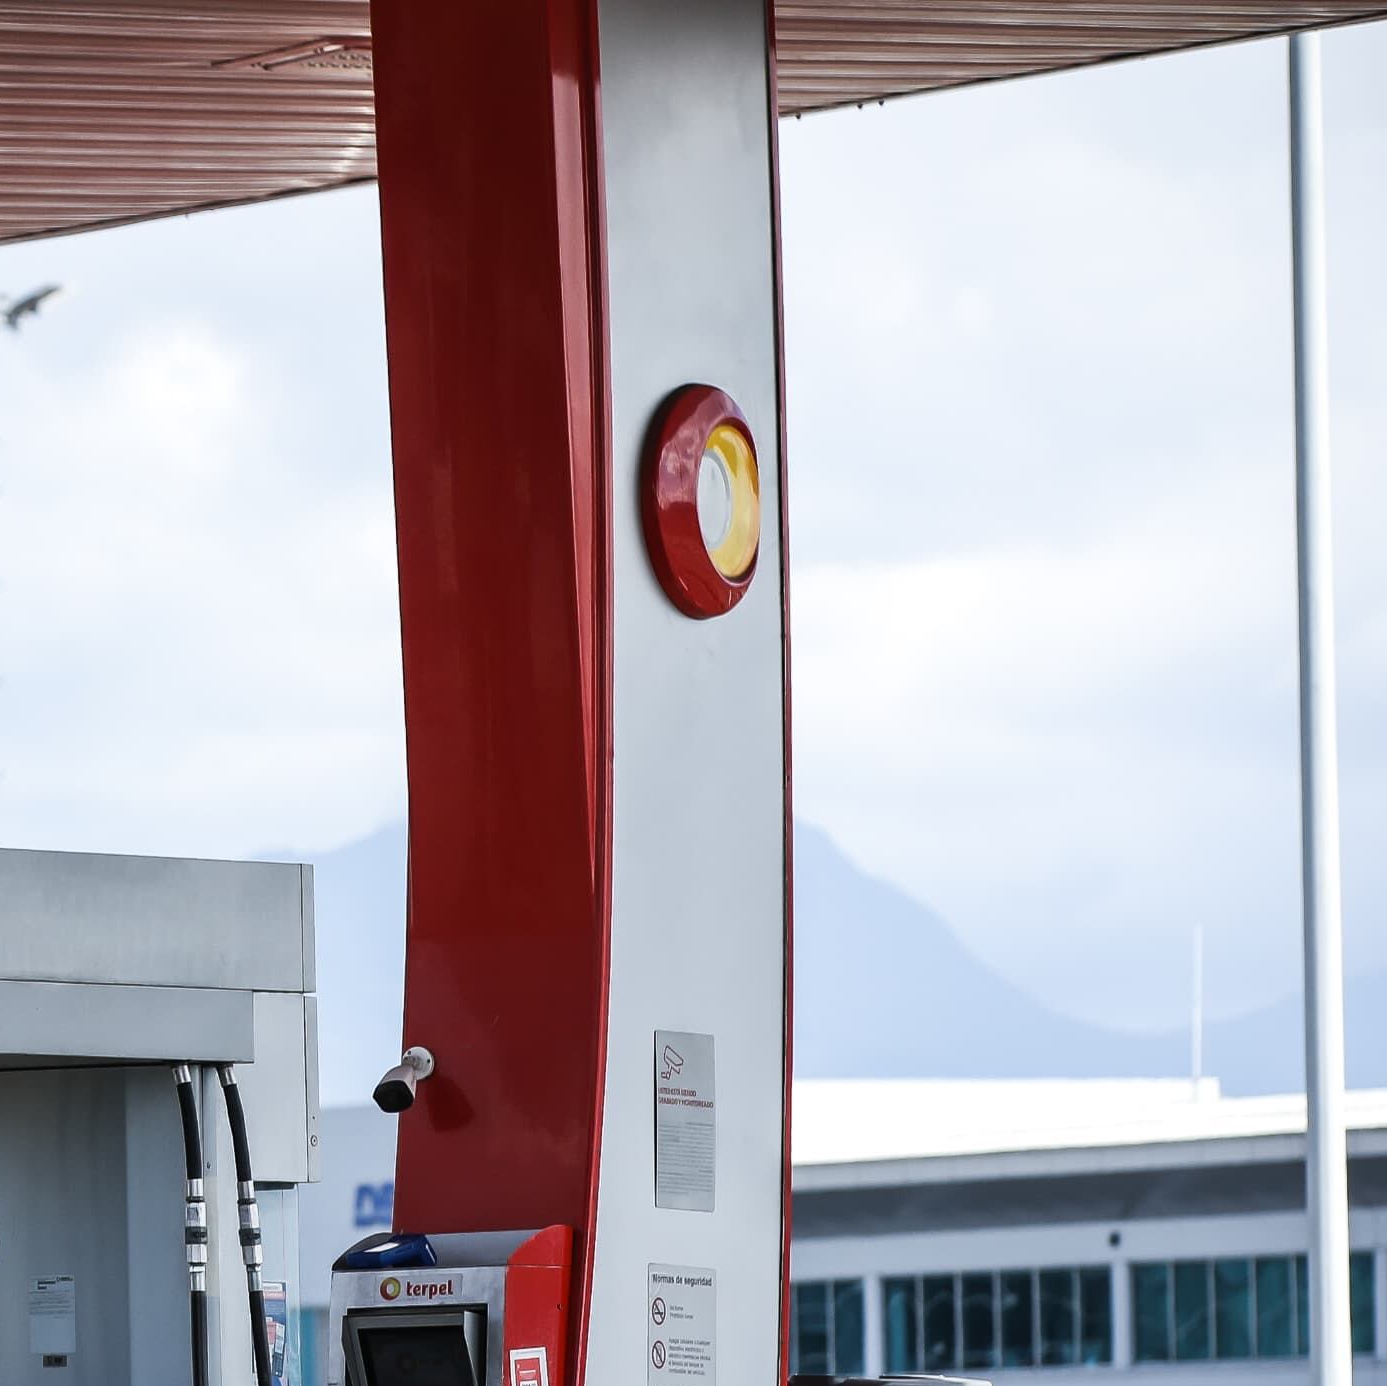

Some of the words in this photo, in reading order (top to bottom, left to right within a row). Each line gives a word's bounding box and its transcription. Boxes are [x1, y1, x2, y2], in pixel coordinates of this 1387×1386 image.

[652, 1274, 674, 1284] Normas
[676, 1275, 683, 1285] de
[684, 1277, 712, 1287] seguridad
[406, 1280, 453, 1299] terpel
